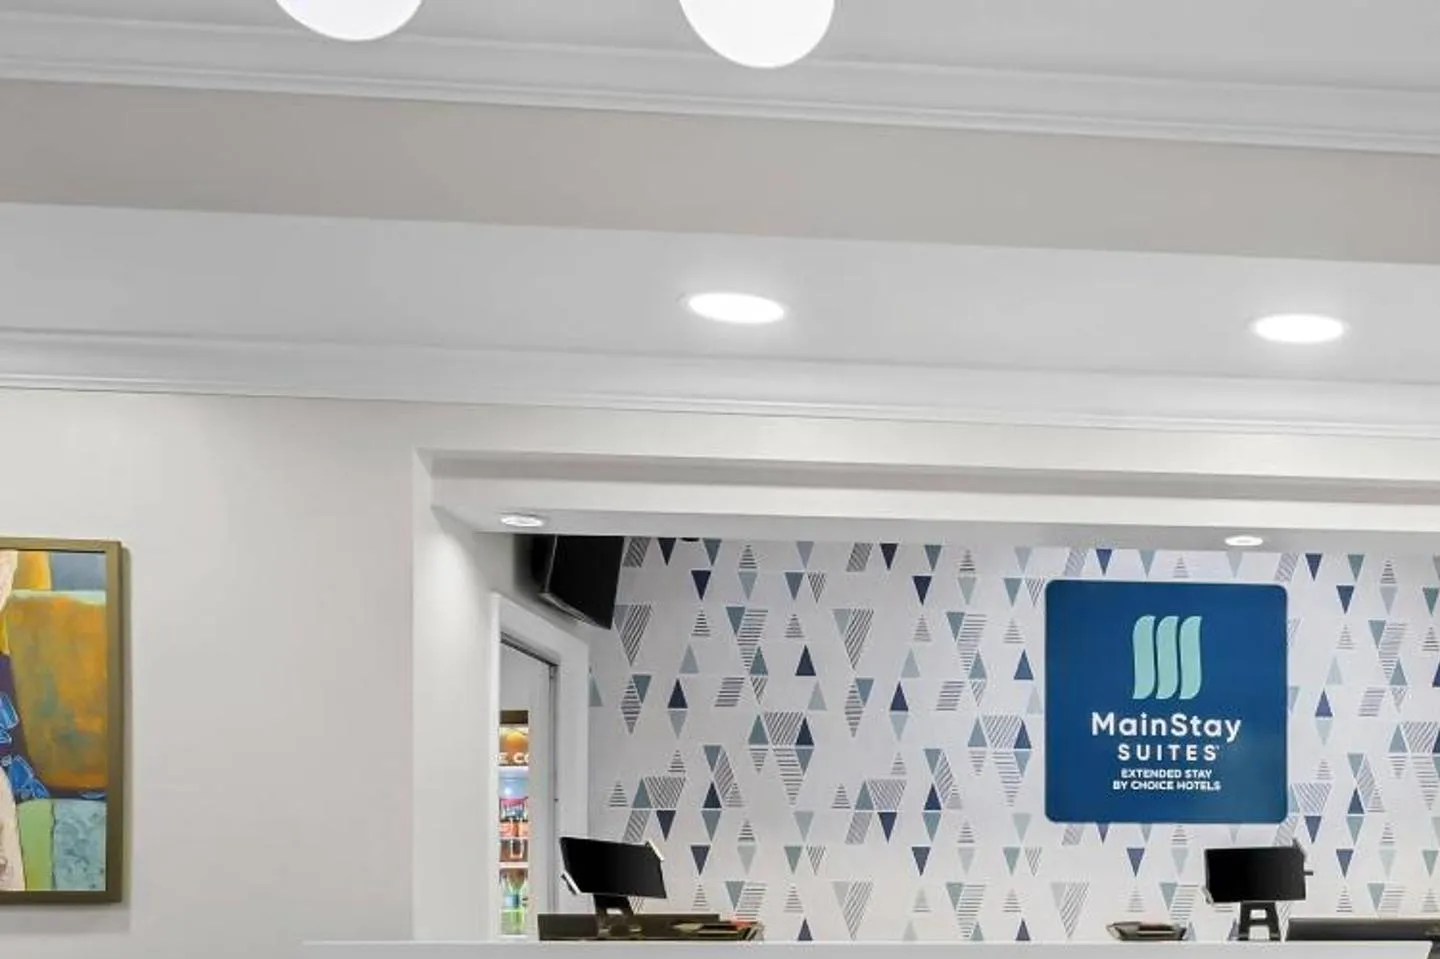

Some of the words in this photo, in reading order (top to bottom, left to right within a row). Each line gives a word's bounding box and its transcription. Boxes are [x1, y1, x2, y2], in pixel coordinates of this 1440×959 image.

[1091, 711, 1241, 743] MainStay
[1117, 743, 1218, 761] SUITES
[1121, 769, 1181, 779] EXTENDED
[1185, 769, 1212, 779] STAY
[1113, 780, 1127, 790] BY
[1130, 780, 1174, 790] CHOICE
[1177, 780, 1221, 791] HOTELS
